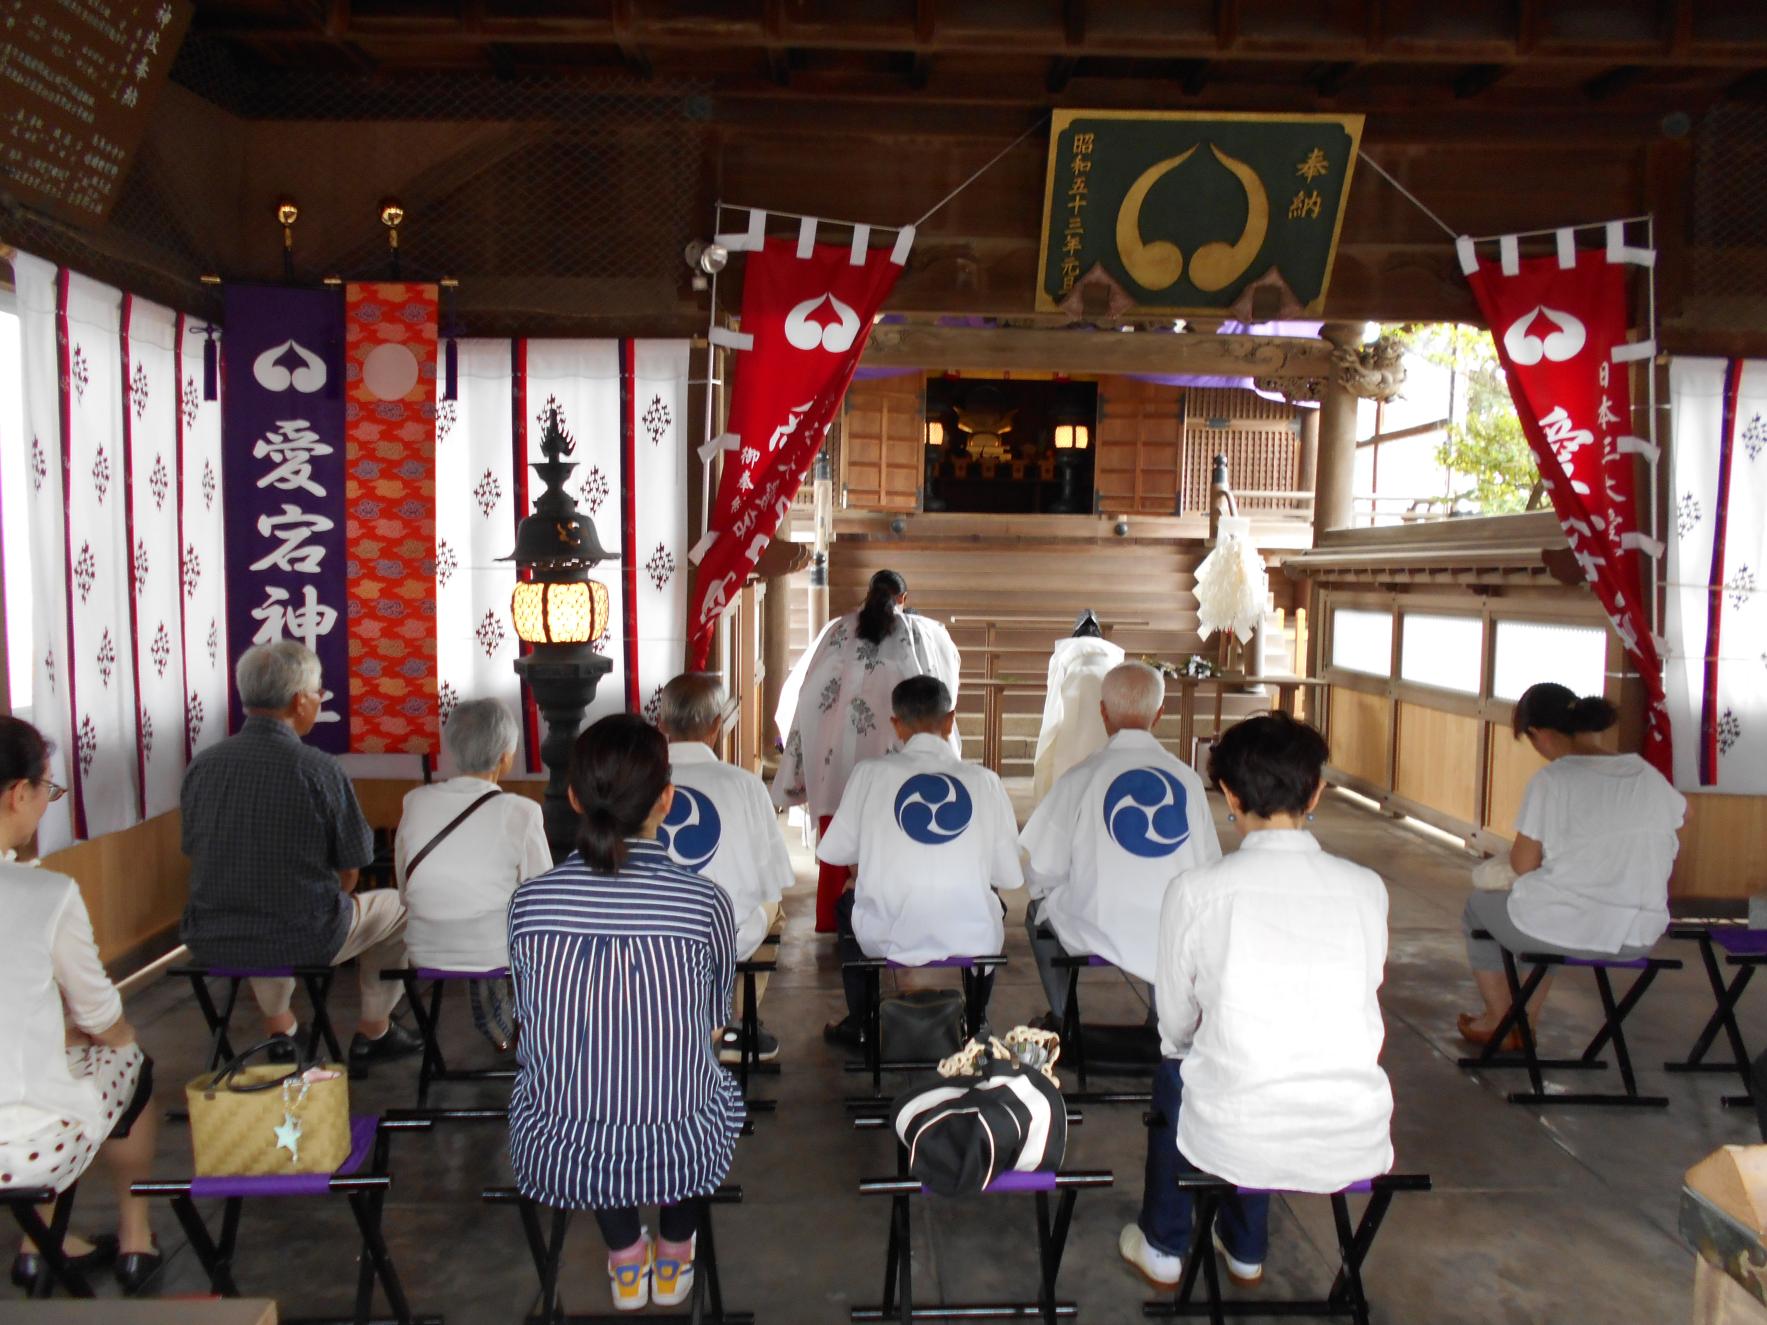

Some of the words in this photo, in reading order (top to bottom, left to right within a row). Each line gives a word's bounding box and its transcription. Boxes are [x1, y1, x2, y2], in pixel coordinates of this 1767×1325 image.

[1058, 132, 1096, 296] 昭和五十三年元旦
[1287, 146, 1329, 220] 奉納
[249, 418, 342, 724] 愛宕神
